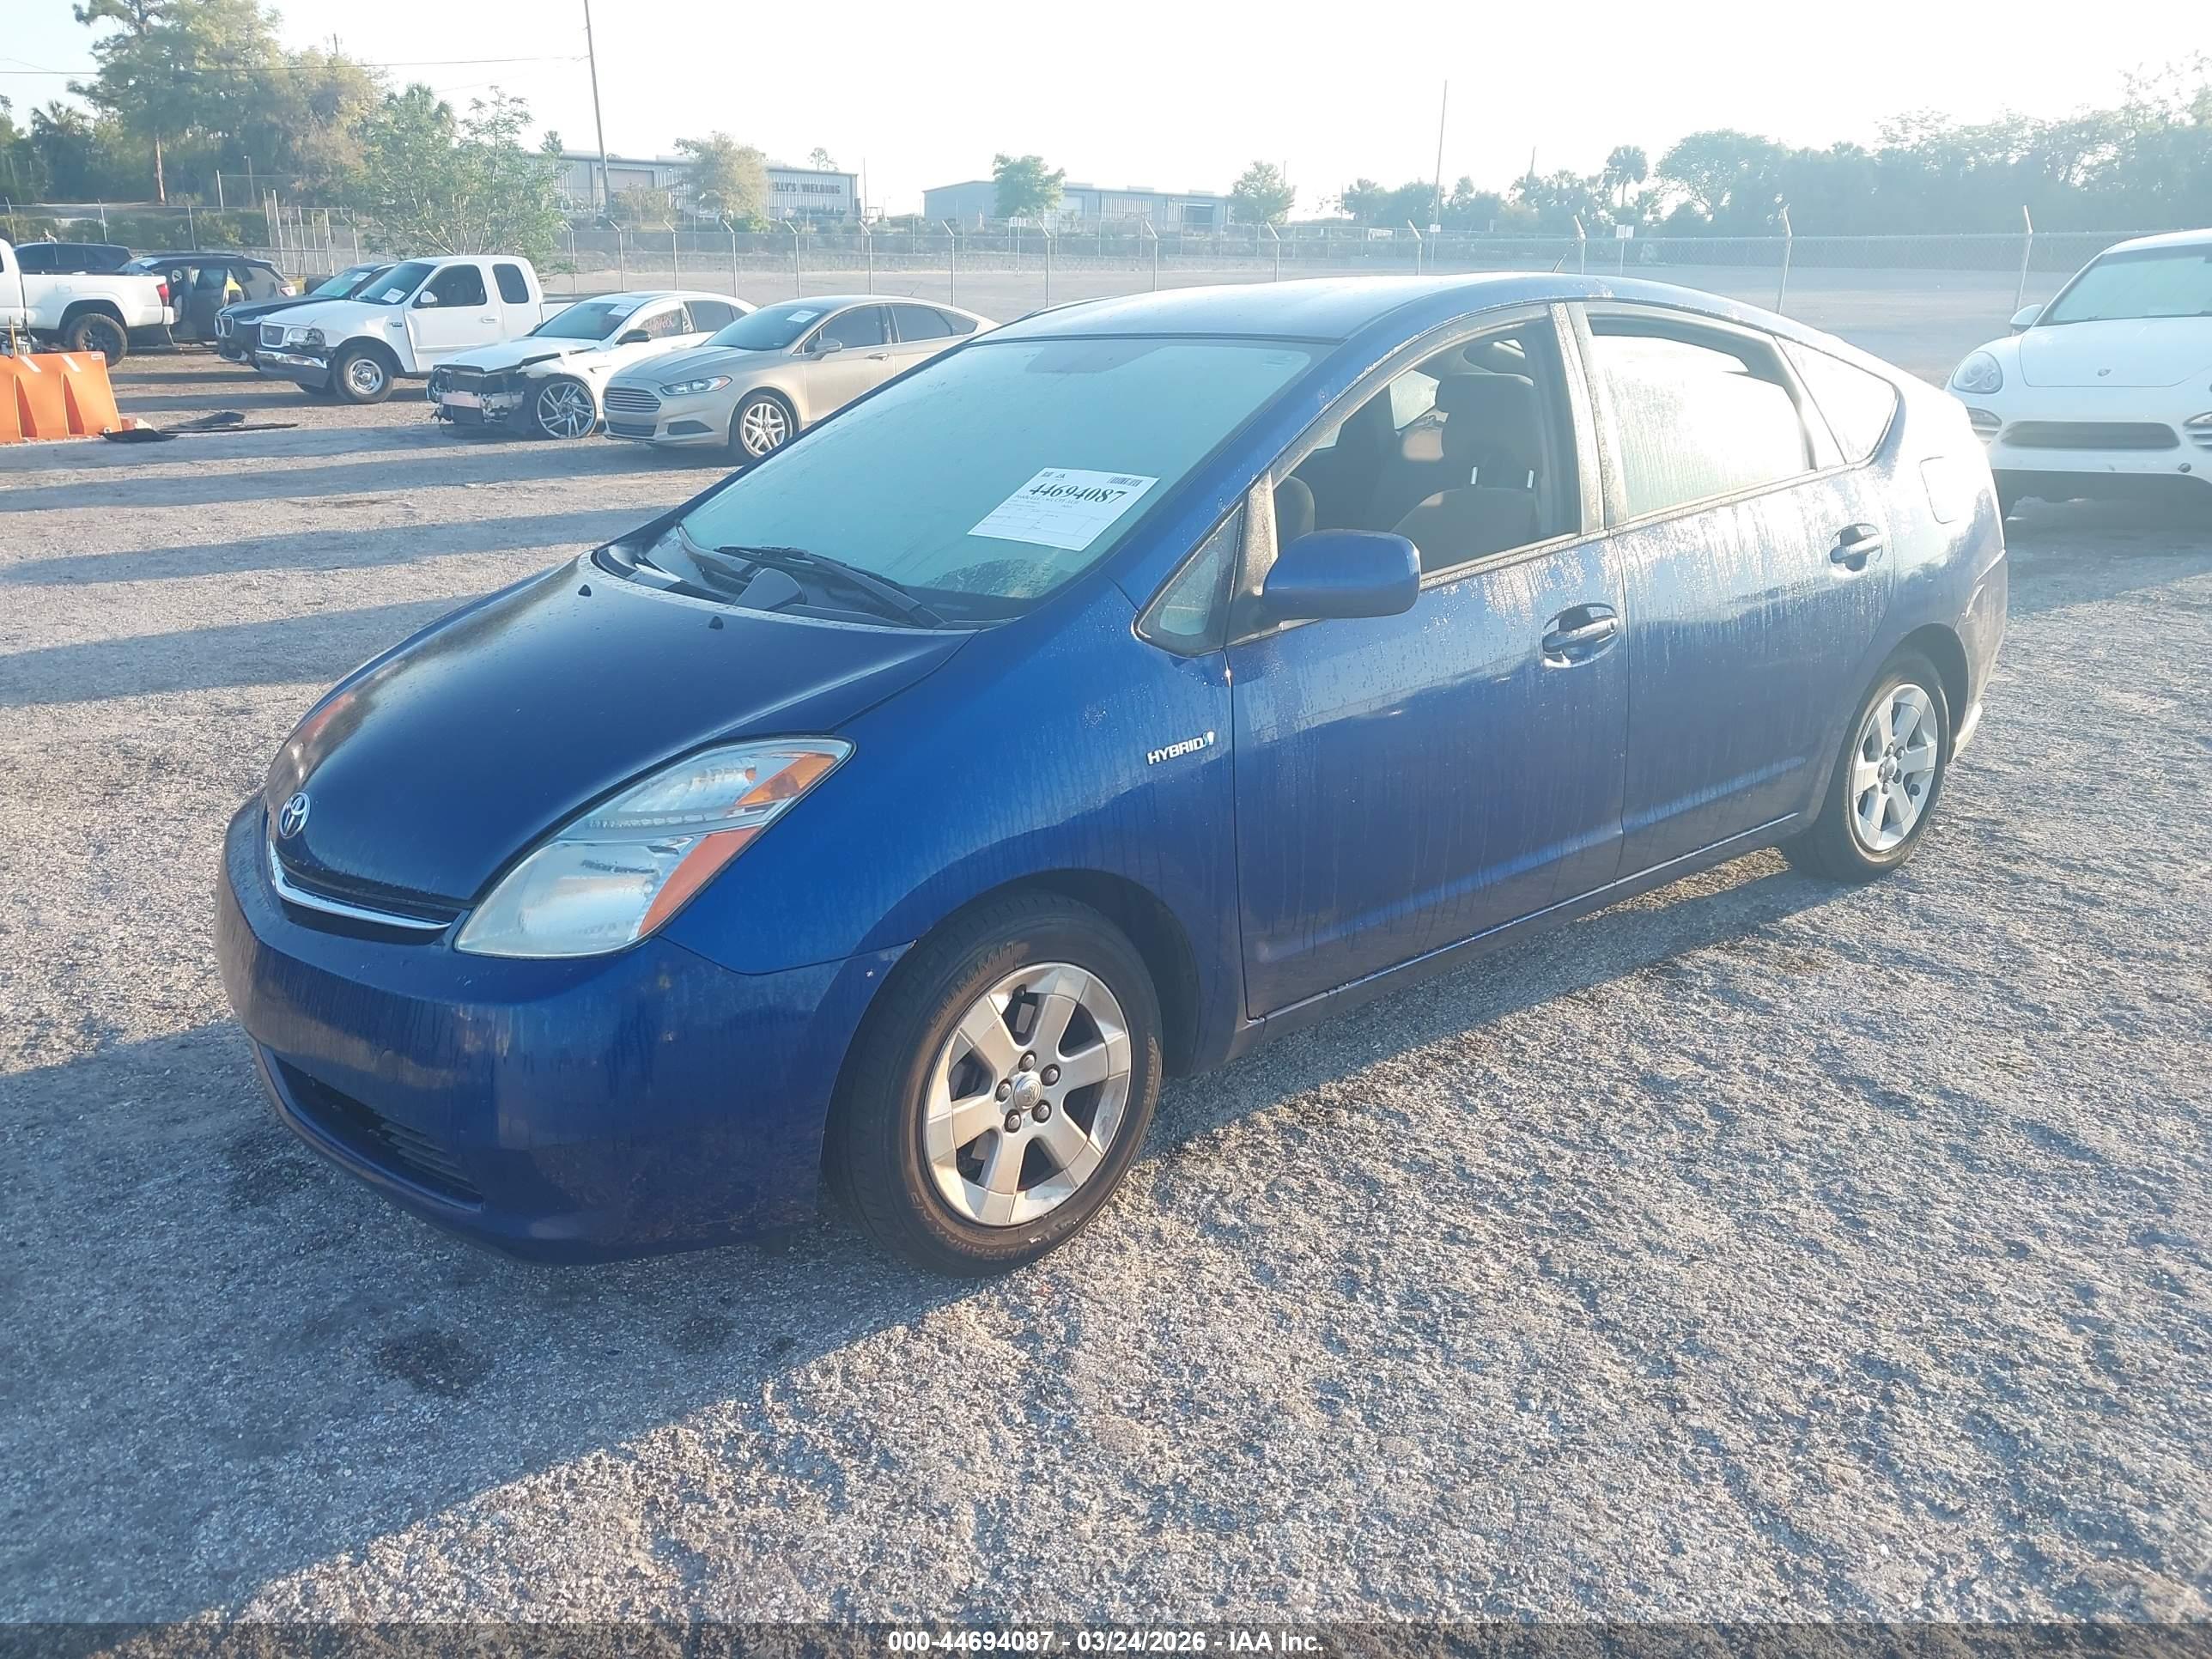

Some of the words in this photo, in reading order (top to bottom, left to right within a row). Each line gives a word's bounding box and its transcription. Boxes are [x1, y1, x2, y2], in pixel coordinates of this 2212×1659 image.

[801, 183, 842, 195] WELDING
[1029, 483, 1128, 504] 44694087
[1146, 737, 1206, 766] HYBRID
[929, 941, 1017, 1030] SUMMIT
